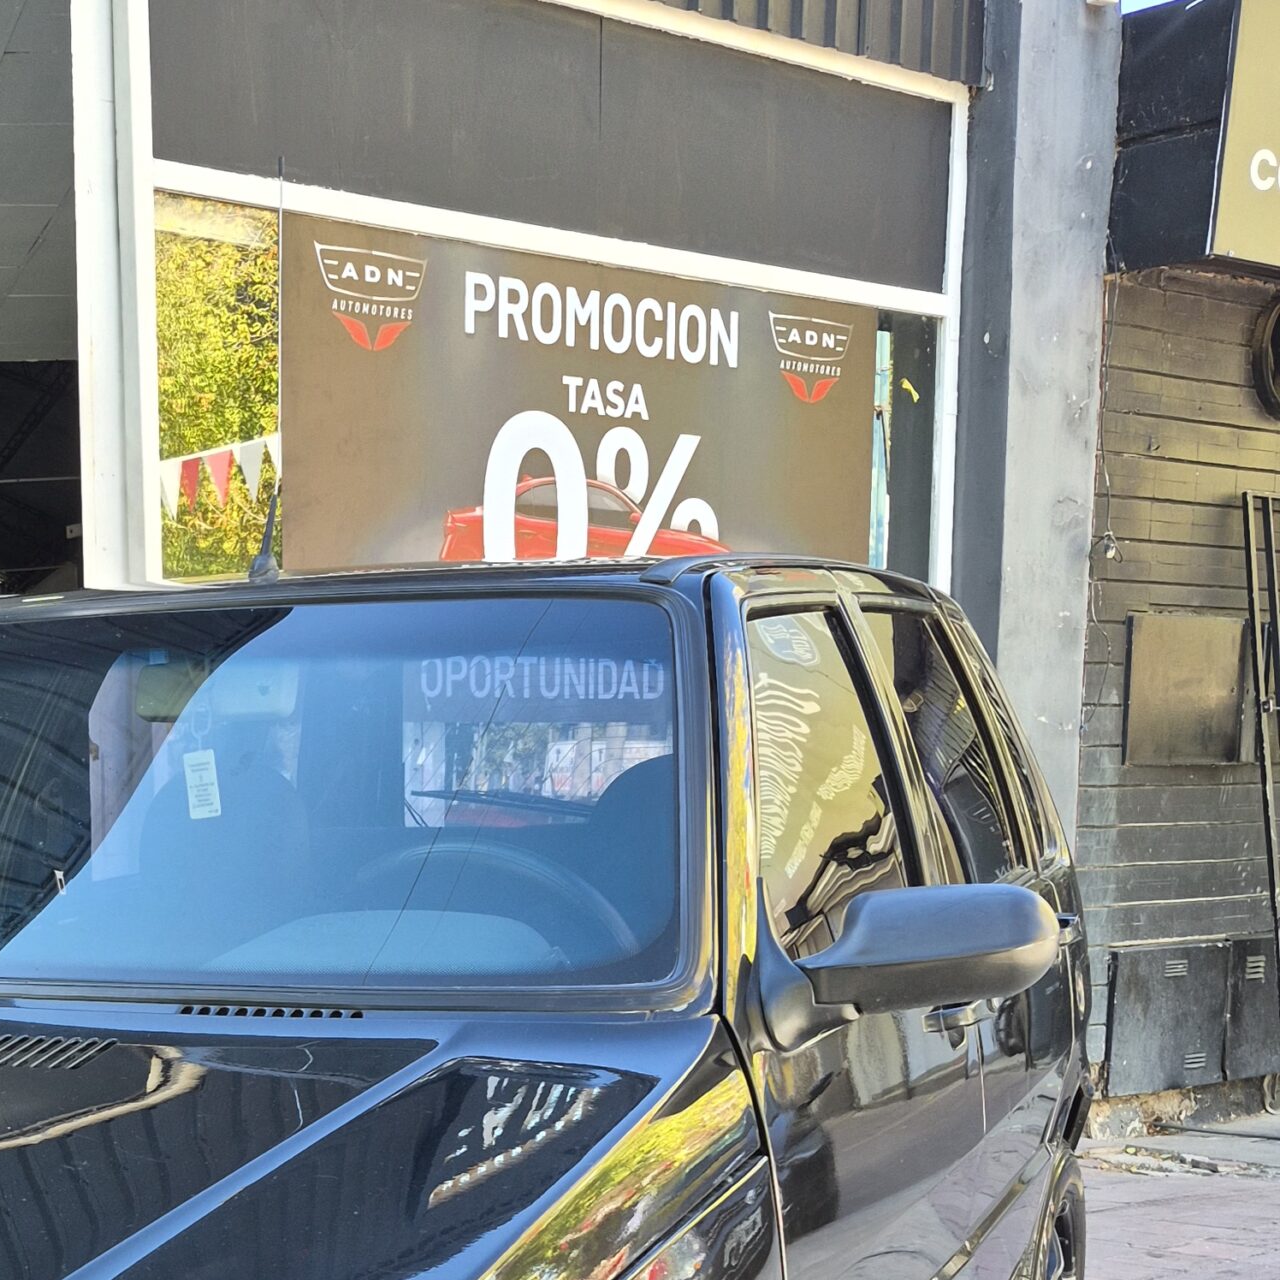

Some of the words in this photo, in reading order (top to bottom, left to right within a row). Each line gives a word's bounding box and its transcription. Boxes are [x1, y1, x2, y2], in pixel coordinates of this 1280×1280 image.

[1250, 148, 1280, 191] C
[341, 262, 403, 287] ADN
[332, 298, 413, 320] AUTOMOTORES
[464, 271, 739, 368] PROMOCION
[788, 328, 835, 349] ADN
[779, 360, 841, 376] AUTOMOTORES
[562, 375, 649, 421] TASA
[483, 410, 719, 562] 0%
[421, 655, 665, 700] OPORTUNIDAD
